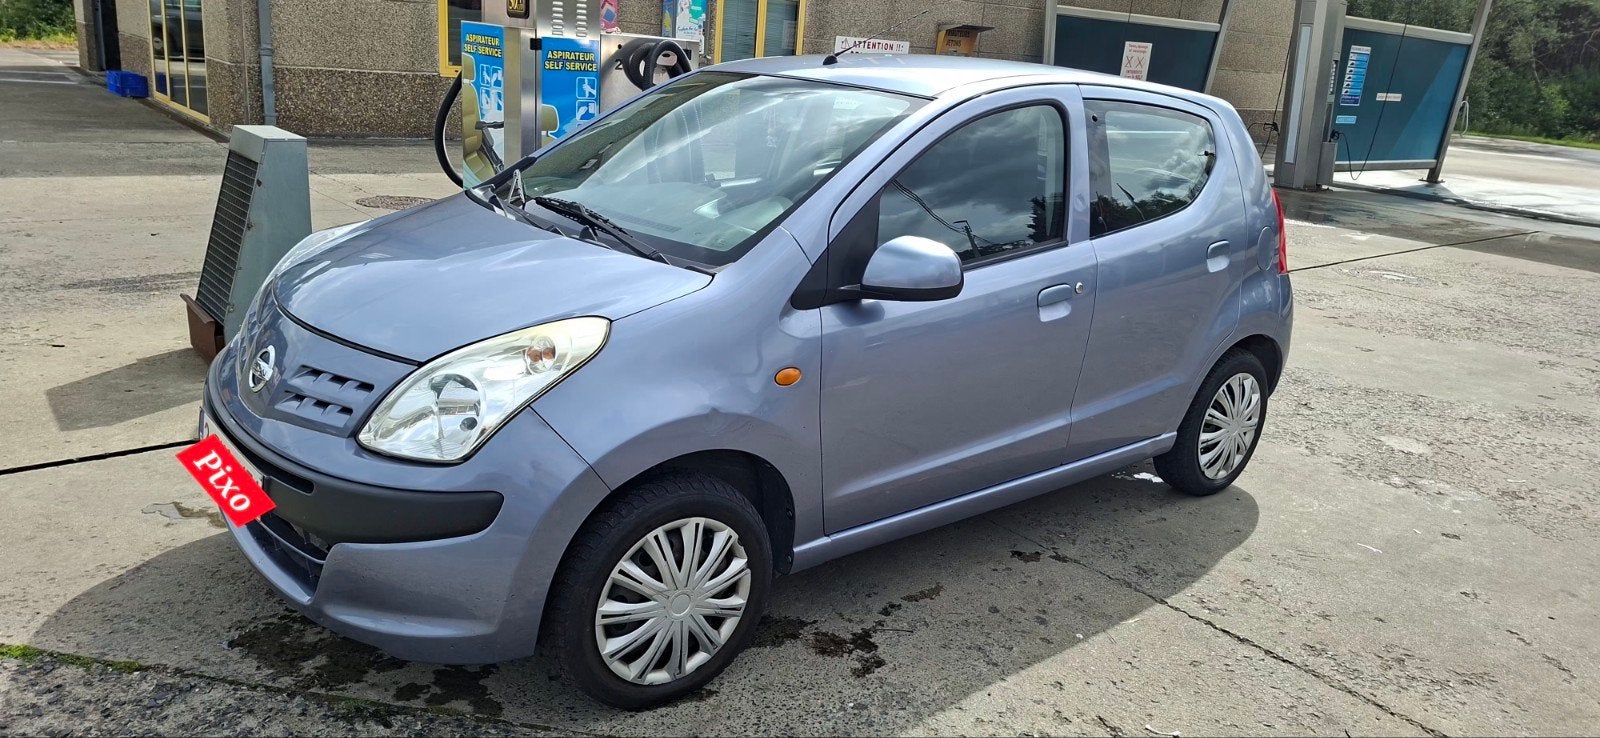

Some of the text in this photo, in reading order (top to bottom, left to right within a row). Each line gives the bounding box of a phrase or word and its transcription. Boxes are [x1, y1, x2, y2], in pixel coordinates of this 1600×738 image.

[465, 34, 500, 46] ASPIRATEUR
[853, 40, 894, 51] ATTENTION
[464, 43, 502, 58] SELF SERVICE
[547, 50, 595, 61] ASPIRATEUR
[544, 60, 598, 72] SELF SERVICE
